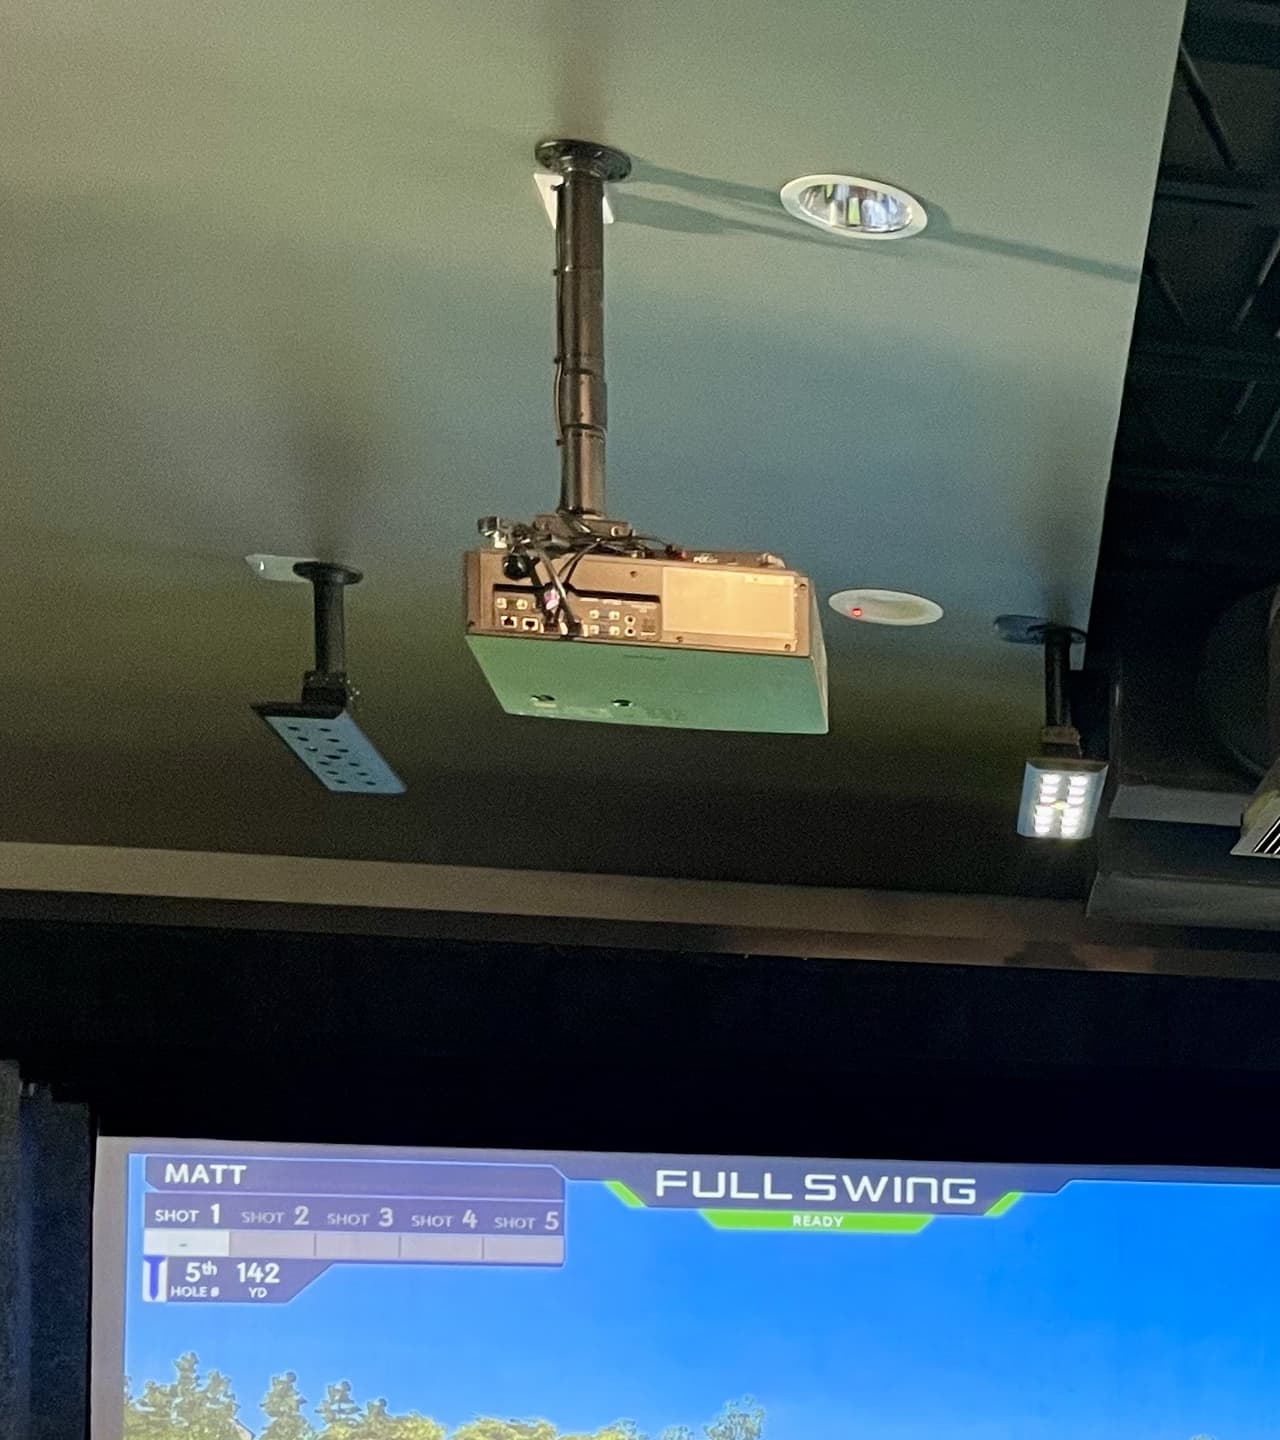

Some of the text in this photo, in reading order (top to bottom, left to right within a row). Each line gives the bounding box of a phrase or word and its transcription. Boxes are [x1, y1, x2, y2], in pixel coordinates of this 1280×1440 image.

[164, 1163, 248, 1187] MATT
[655, 1169, 977, 1205] FULL SWING
[154, 1203, 221, 1225] SHOT 1
[241, 1205, 310, 1226] SHOT 2
[327, 1207, 394, 1228] SHOT 3
[411, 1208, 478, 1229] SHOT 4
[494, 1210, 560, 1231] SHOT 5
[792, 1215, 844, 1228] READY
[184, 1261, 280, 1284] 5th 142
[171, 1286, 208, 1298] HOLE
[248, 1286, 267, 1298] YD
